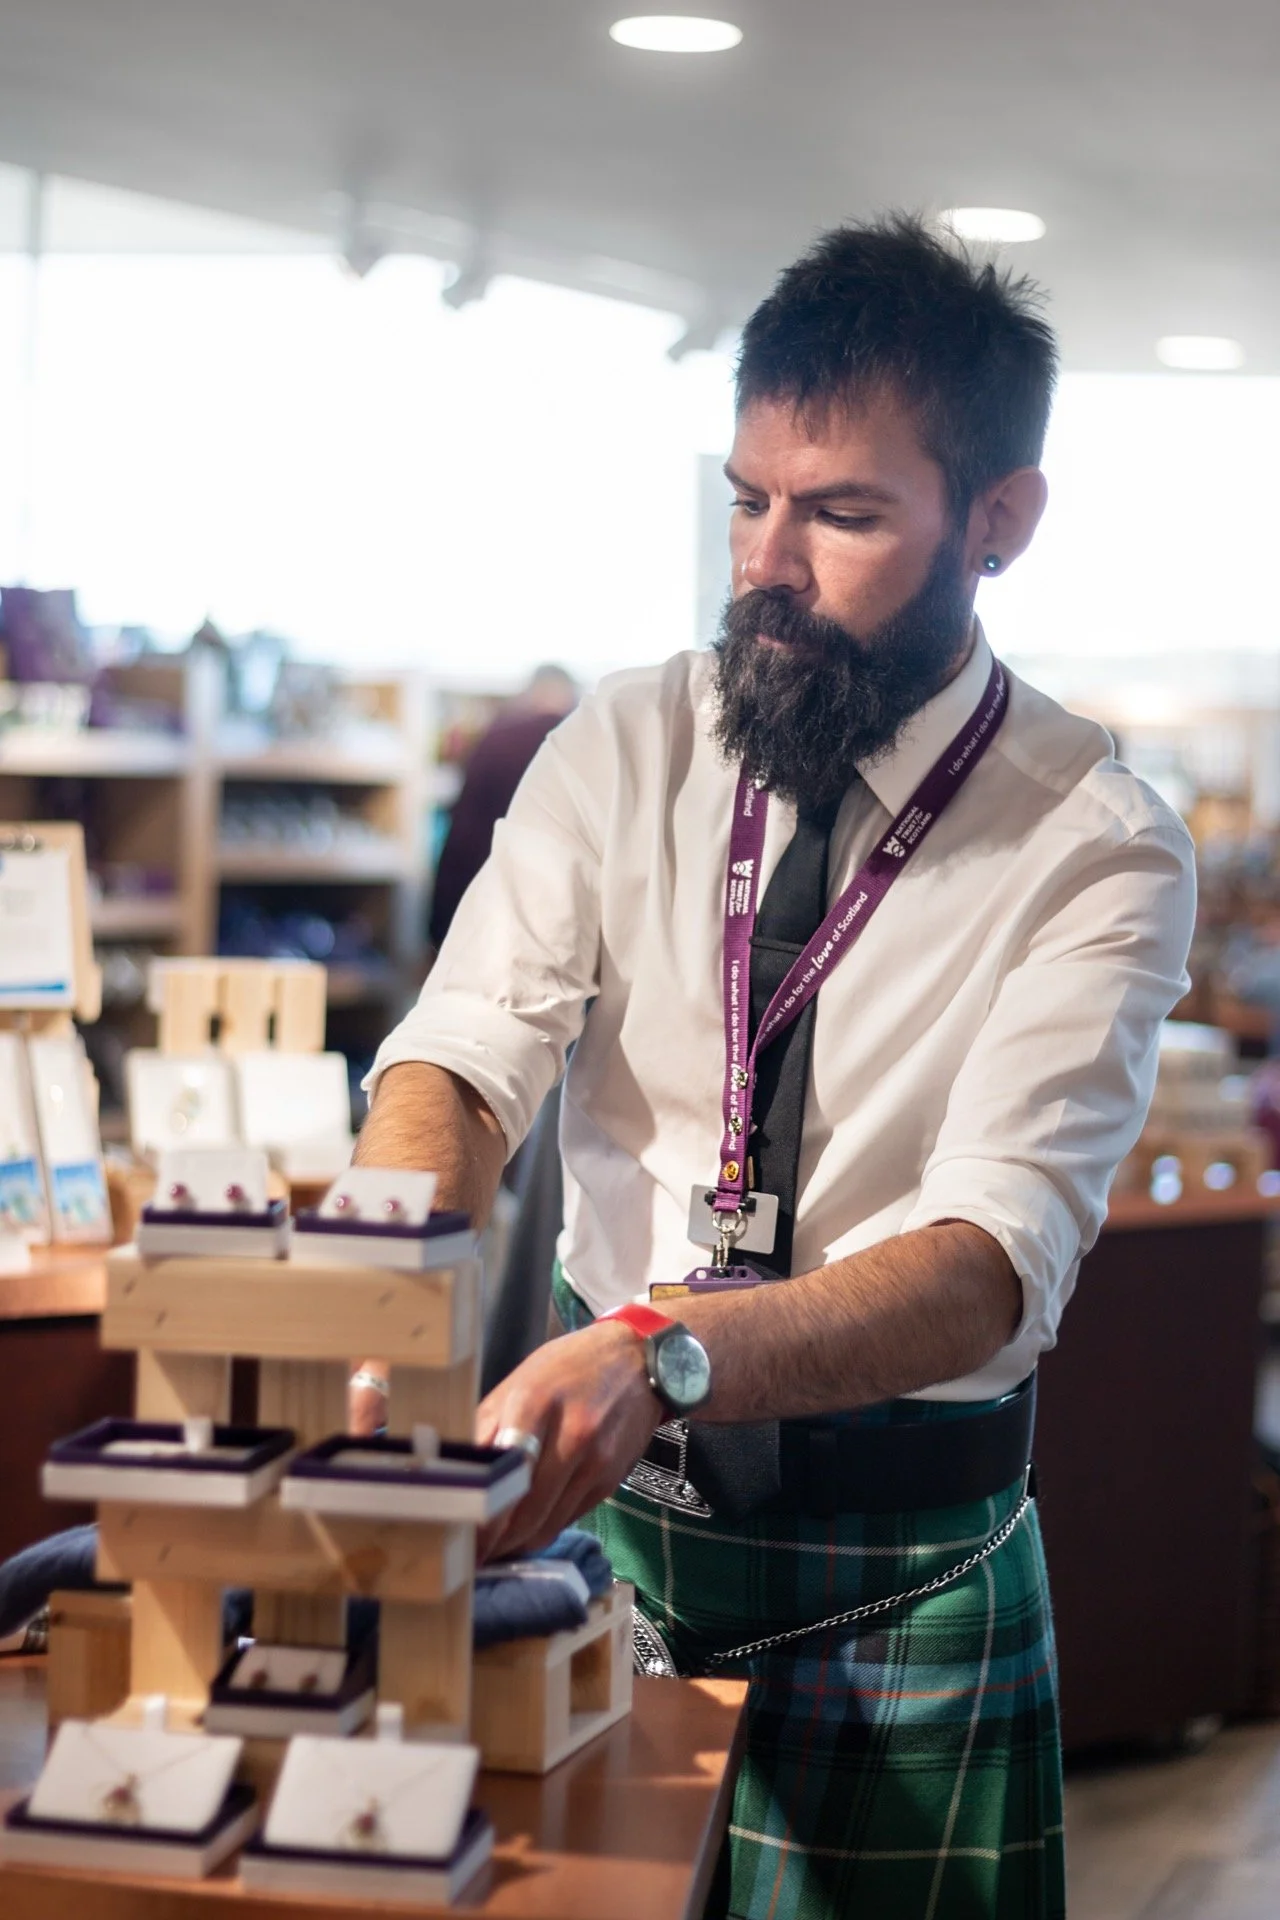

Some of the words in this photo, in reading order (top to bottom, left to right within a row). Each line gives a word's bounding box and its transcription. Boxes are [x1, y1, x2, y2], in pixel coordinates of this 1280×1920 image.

[953, 758, 964, 771] do
[961, 736, 979, 759] what
[979, 720, 989, 734] do
[894, 806, 919, 837] NATIONAL
[900, 819, 917, 839] TRUST
[907, 812, 932, 845] SCOTLAND
[729, 879, 737, 917] SCOTLAND
[731, 965, 740, 980] do
[766, 1012, 783, 1032] what
[784, 997, 796, 1009] do
[791, 983, 806, 996] for
[802, 967, 817, 984] the
[832, 928, 842, 942] of
[837, 891, 869, 932] Scotland
[731, 981, 740, 1006] what
[731, 1012, 740, 1027] do
[731, 1028, 740, 1043] for
[732, 1044, 740, 1062] the
[730, 1094, 738, 1105] of
